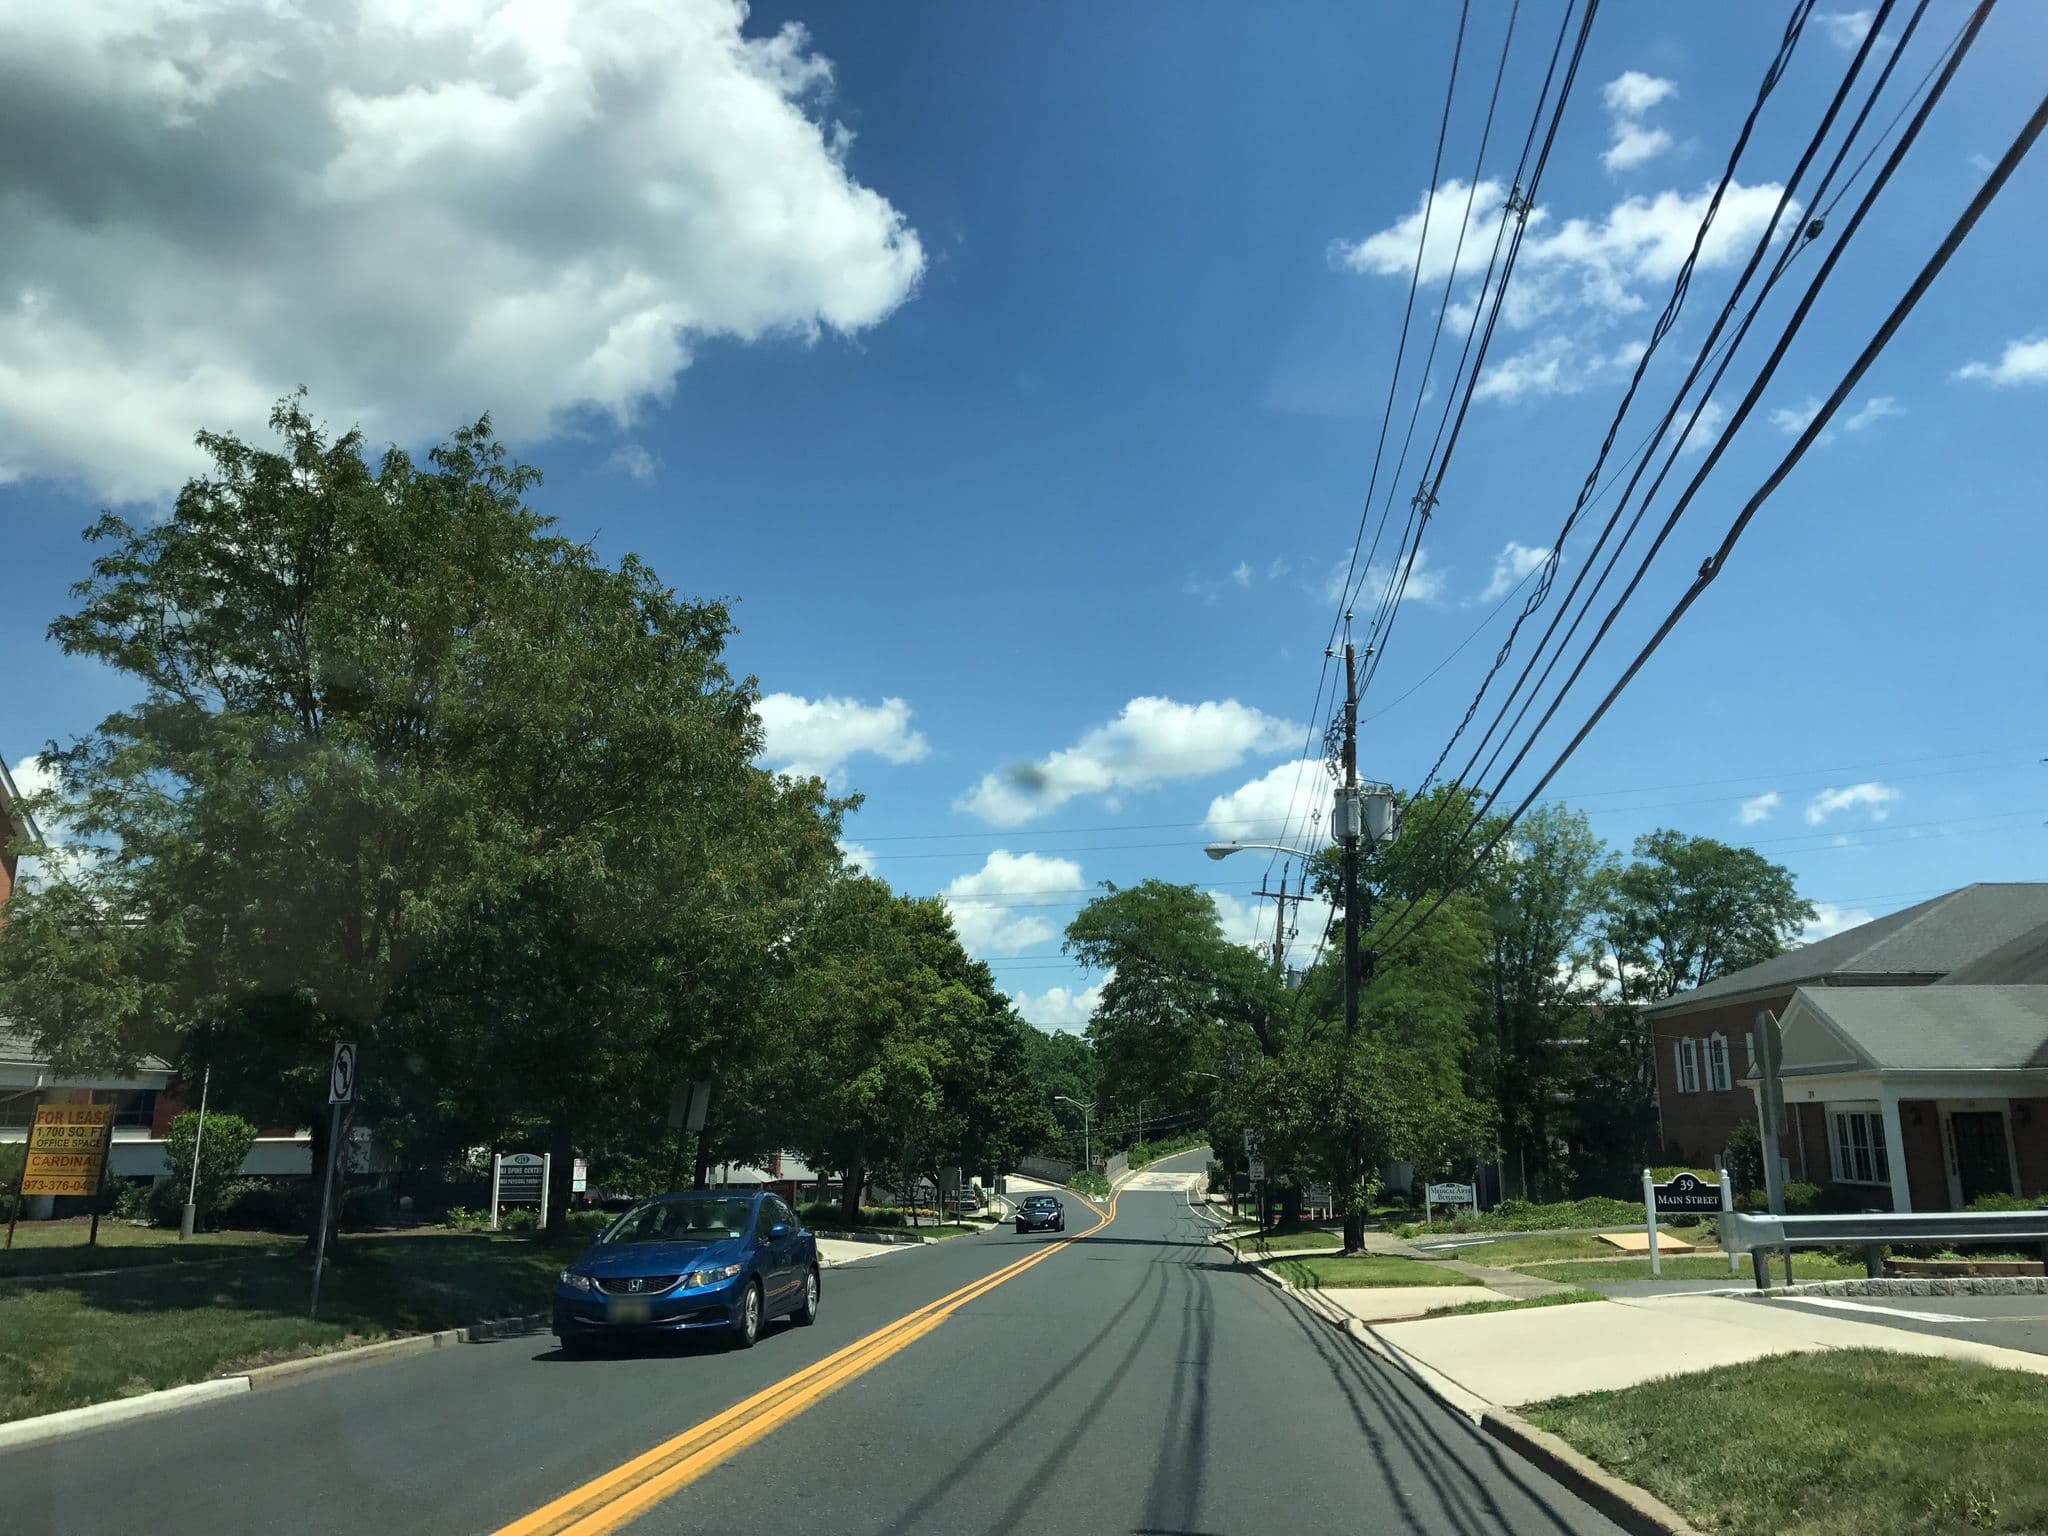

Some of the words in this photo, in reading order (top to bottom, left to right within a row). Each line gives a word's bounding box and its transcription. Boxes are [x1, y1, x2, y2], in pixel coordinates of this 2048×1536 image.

[37, 1111, 65, 1125] FOR
[37, 1126, 65, 1138] 1,700
[68, 1126, 87, 1138] SQ.
[36, 1139, 70, 1148] OFFICE
[72, 1139, 102, 1148] SPACE
[32, 1156, 99, 1167] CARDINAL
[1680, 1179, 1694, 1191] 39
[1657, 1195, 1683, 1205] MAIN
[1685, 1194, 1719, 1205] STREET
